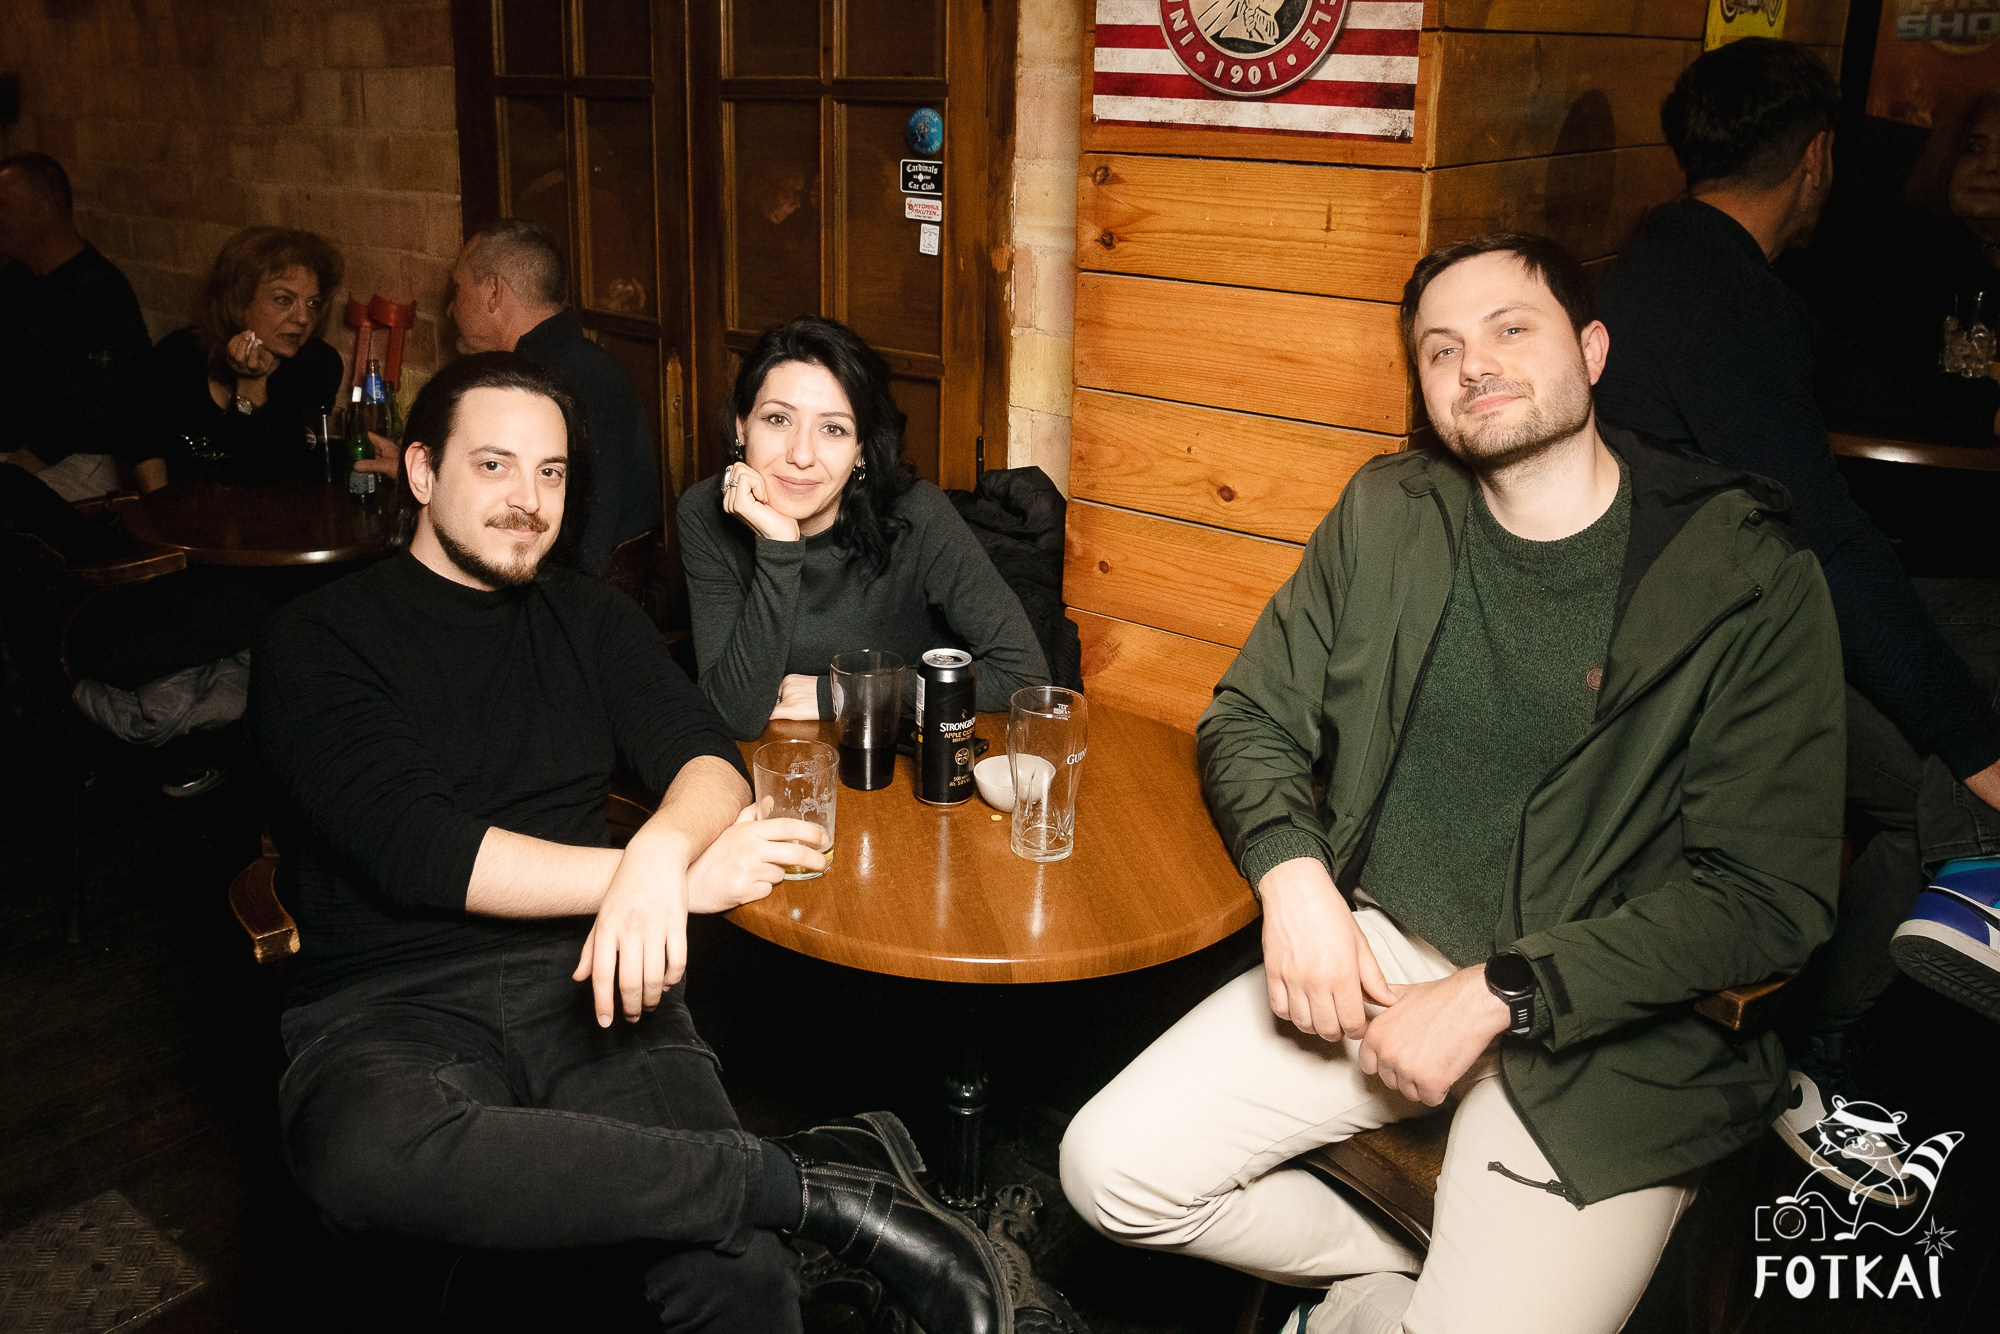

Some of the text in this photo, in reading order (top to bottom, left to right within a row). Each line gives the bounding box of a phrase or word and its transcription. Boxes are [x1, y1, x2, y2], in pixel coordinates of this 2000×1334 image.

[1167, 0, 1195, 46] IN
[1300, 0, 1337, 50] LE
[1214, 60, 1278, 85] 1901
[906, 163, 938, 174] Cardinals
[908, 181, 935, 190] Car Club
[944, 731, 962, 739] APPLE
